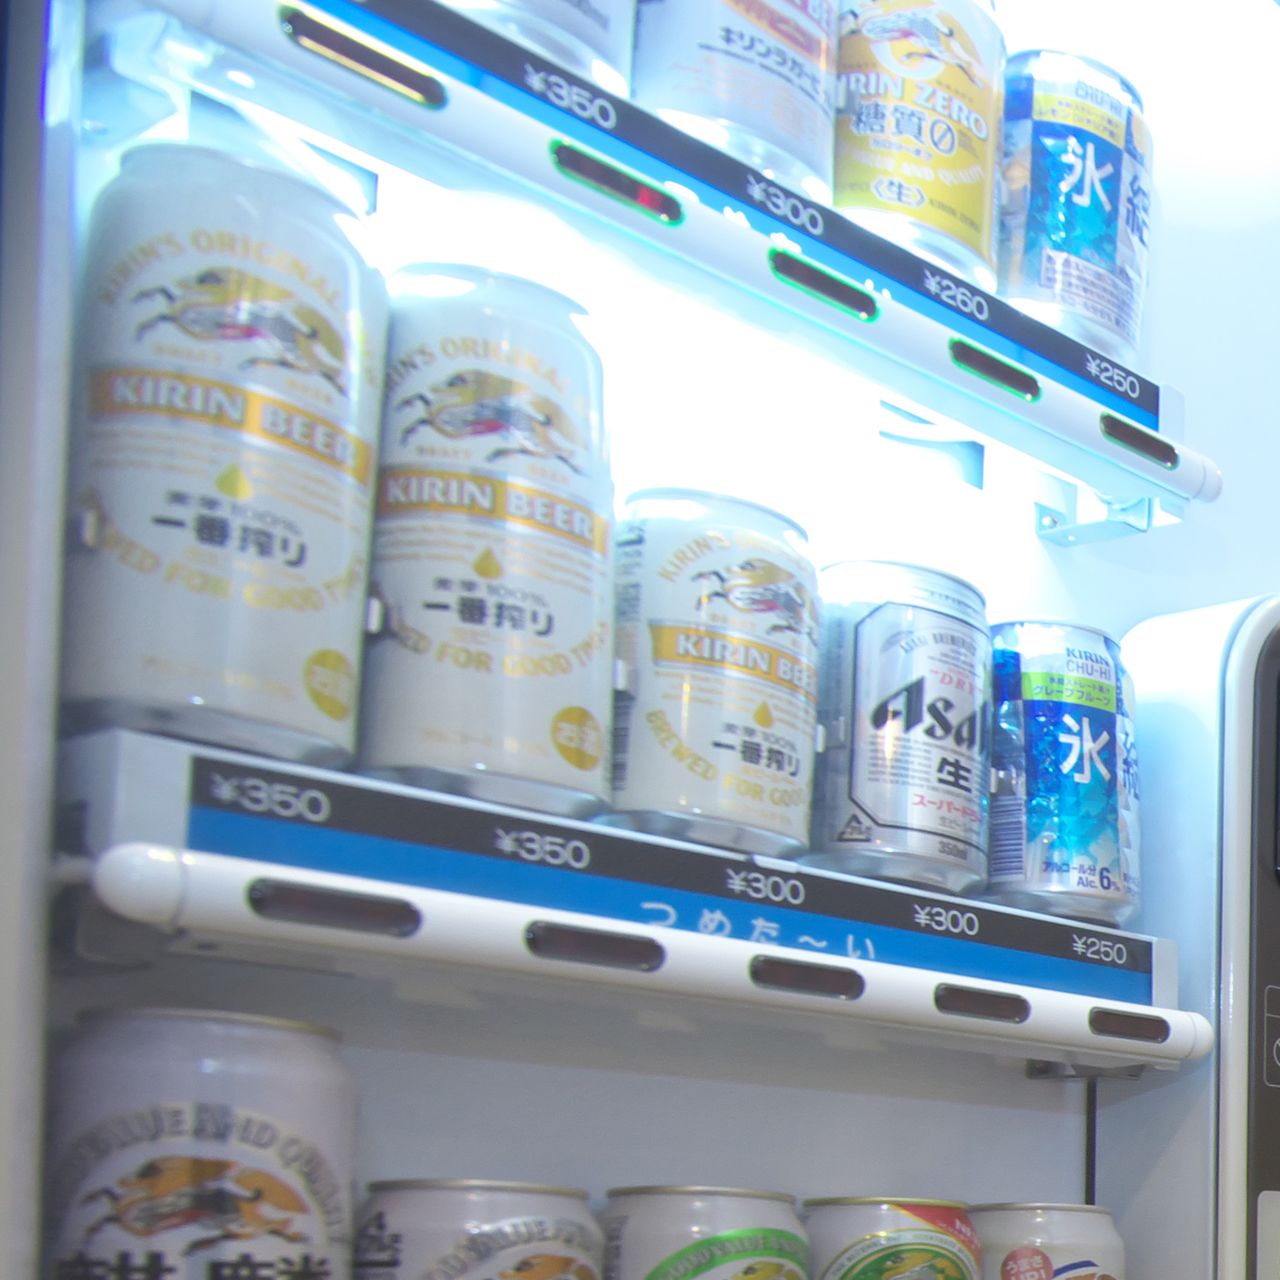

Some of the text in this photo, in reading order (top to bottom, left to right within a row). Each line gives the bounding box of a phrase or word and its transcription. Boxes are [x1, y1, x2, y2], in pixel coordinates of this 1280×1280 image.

[523, 62, 617, 130] ¥350
[913, 82, 989, 141] ZERO
[1059, 135, 1114, 213] 氷
[746, 173, 824, 237] ¥300
[923, 268, 989, 322] ¥260
[1085, 353, 1140, 400] ¥250
[110, 374, 359, 468] KIRIN BEER
[385, 471, 494, 510] KIRIN
[504, 489, 595, 539] BEER
[657, 530, 730, 583] KIRIN'S
[435, 640, 573, 678] FOR GOOD
[676, 632, 772, 675] KIRIN
[1065, 646, 1112, 667] KIRIN
[1065, 659, 1112, 681] CHU-HI
[1033, 683, 1111, 705] グレープフルーツ
[870, 676, 990, 757] Asa
[1058, 713, 1111, 784] 氷
[722, 772, 765, 801] FOR
[937, 756, 973, 794] 生
[209, 770, 331, 823] ¥350
[493, 827, 591, 869] ¥350
[1042, 861, 1097, 876] アルコール分
[726, 868, 806, 905] ¥300
[1076, 874, 1098, 889] Alc.
[913, 904, 980, 936] ¥300
[1072, 933, 1127, 965] ¥250
[1006, 1254, 1044, 1273] うまさ
